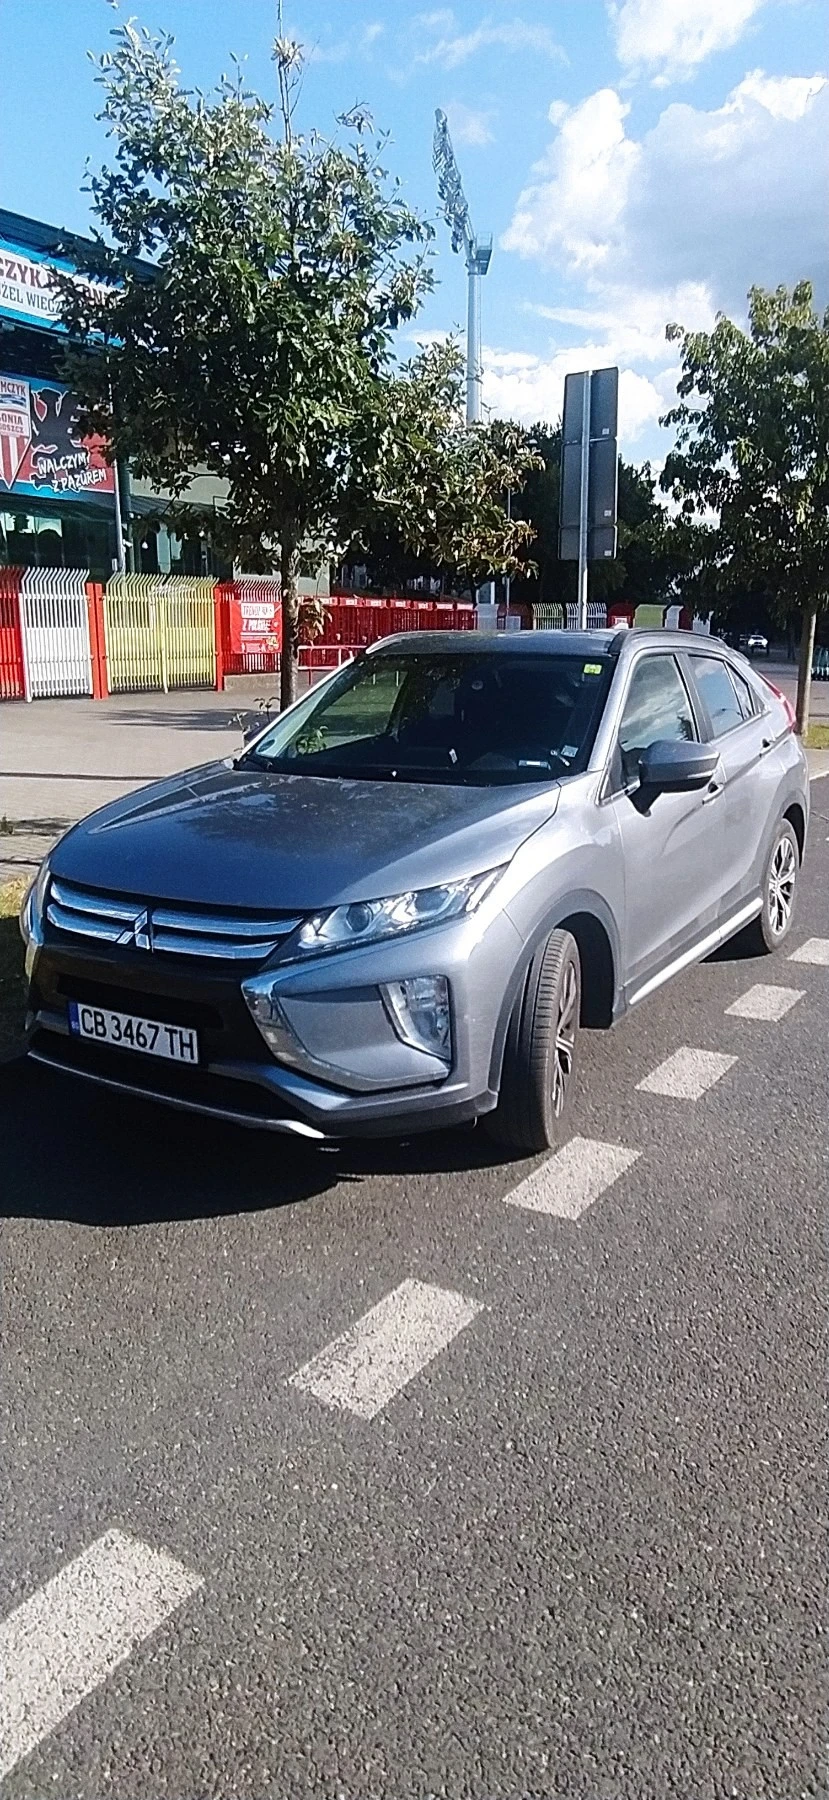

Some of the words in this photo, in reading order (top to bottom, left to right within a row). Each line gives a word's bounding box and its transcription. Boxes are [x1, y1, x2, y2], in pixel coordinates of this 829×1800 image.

[0, 412, 23, 426] ONIA
[81, 1008, 107, 1038] CB
[110, 1015, 160, 1050] 3467
[164, 1026, 195, 1061] TH
